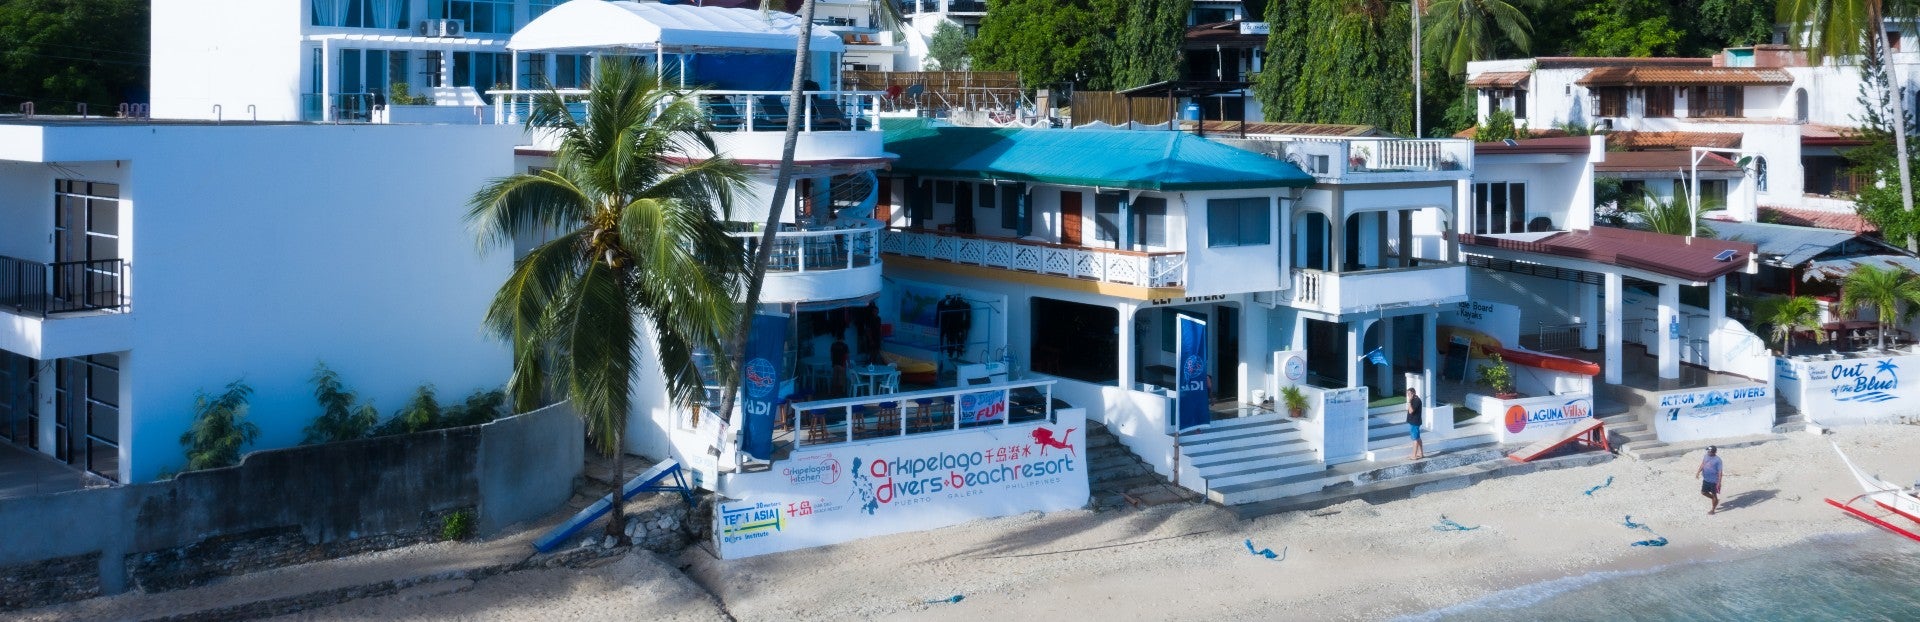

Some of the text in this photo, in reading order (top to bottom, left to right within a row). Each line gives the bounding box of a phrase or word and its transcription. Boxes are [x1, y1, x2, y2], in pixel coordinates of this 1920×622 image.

[1460, 308, 1483, 320] Kayaks
[1473, 301, 1494, 312] Board
[1831, 362, 1868, 380] Out
[1733, 387, 1766, 399] DIVERS
[1830, 375, 1894, 397] of the Blue
[745, 399, 772, 416] ADI
[976, 399, 1005, 421] FUN
[1527, 408, 1563, 422] LAGUNA
[1563, 404, 1587, 417] Villas
[985, 444, 1032, 464] 千岛潜水
[870, 451, 983, 478] arkipelago
[790, 473, 820, 484] kitchen
[894, 478, 1061, 507] PUERTO GALERA PHILIPPINES
[754, 509, 775, 522] ASIA
[787, 500, 813, 518] 千岛
